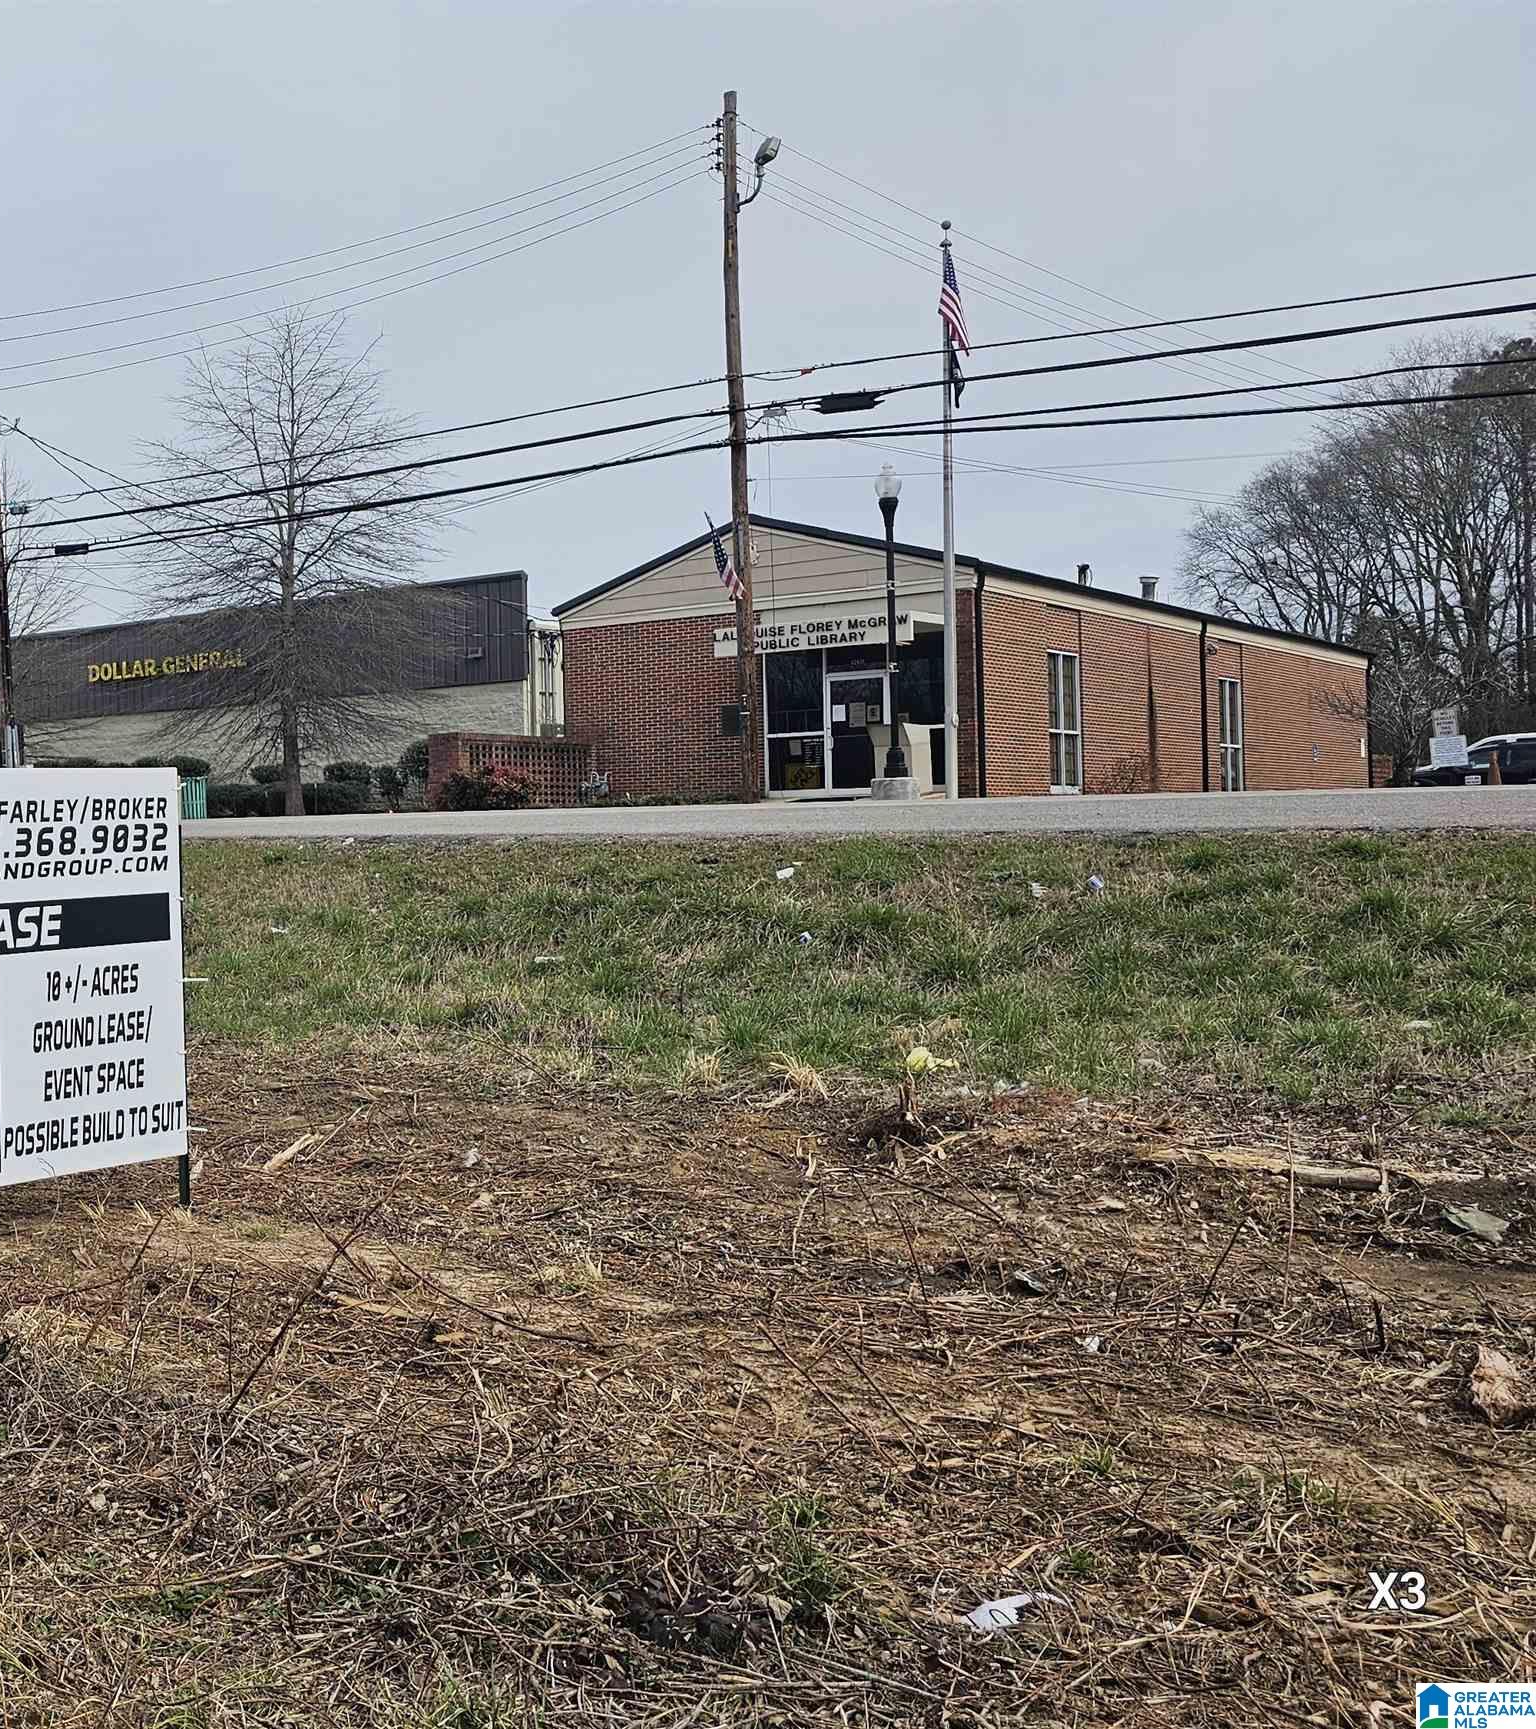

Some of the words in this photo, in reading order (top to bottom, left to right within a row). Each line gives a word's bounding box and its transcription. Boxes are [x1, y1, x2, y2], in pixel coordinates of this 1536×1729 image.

[714, 625, 785, 643] LALUISE
[790, 619, 843, 635] FLOREY
[848, 614, 909, 630] McGRW
[807, 631, 867, 646] LIBRARY
[87, 658, 158, 683] DOLLAR
[163, 648, 248, 674] GENERAL
[46, 971, 61, 1002] 10
[65, 964, 88, 1003] +/-
[91, 963, 139, 997] ACRES
[33, 1016, 94, 1053] GROUND
[98, 1005, 152, 1044] LEASE/
[44, 1065, 93, 1102] EVENT
[97, 1058, 145, 1094] SPACE
[4, 1116, 79, 1159] POSSIBLE
[82, 1109, 124, 1145] BUILD
[129, 1106, 148, 1137] TO
[152, 1101, 183, 1134] SUIT
